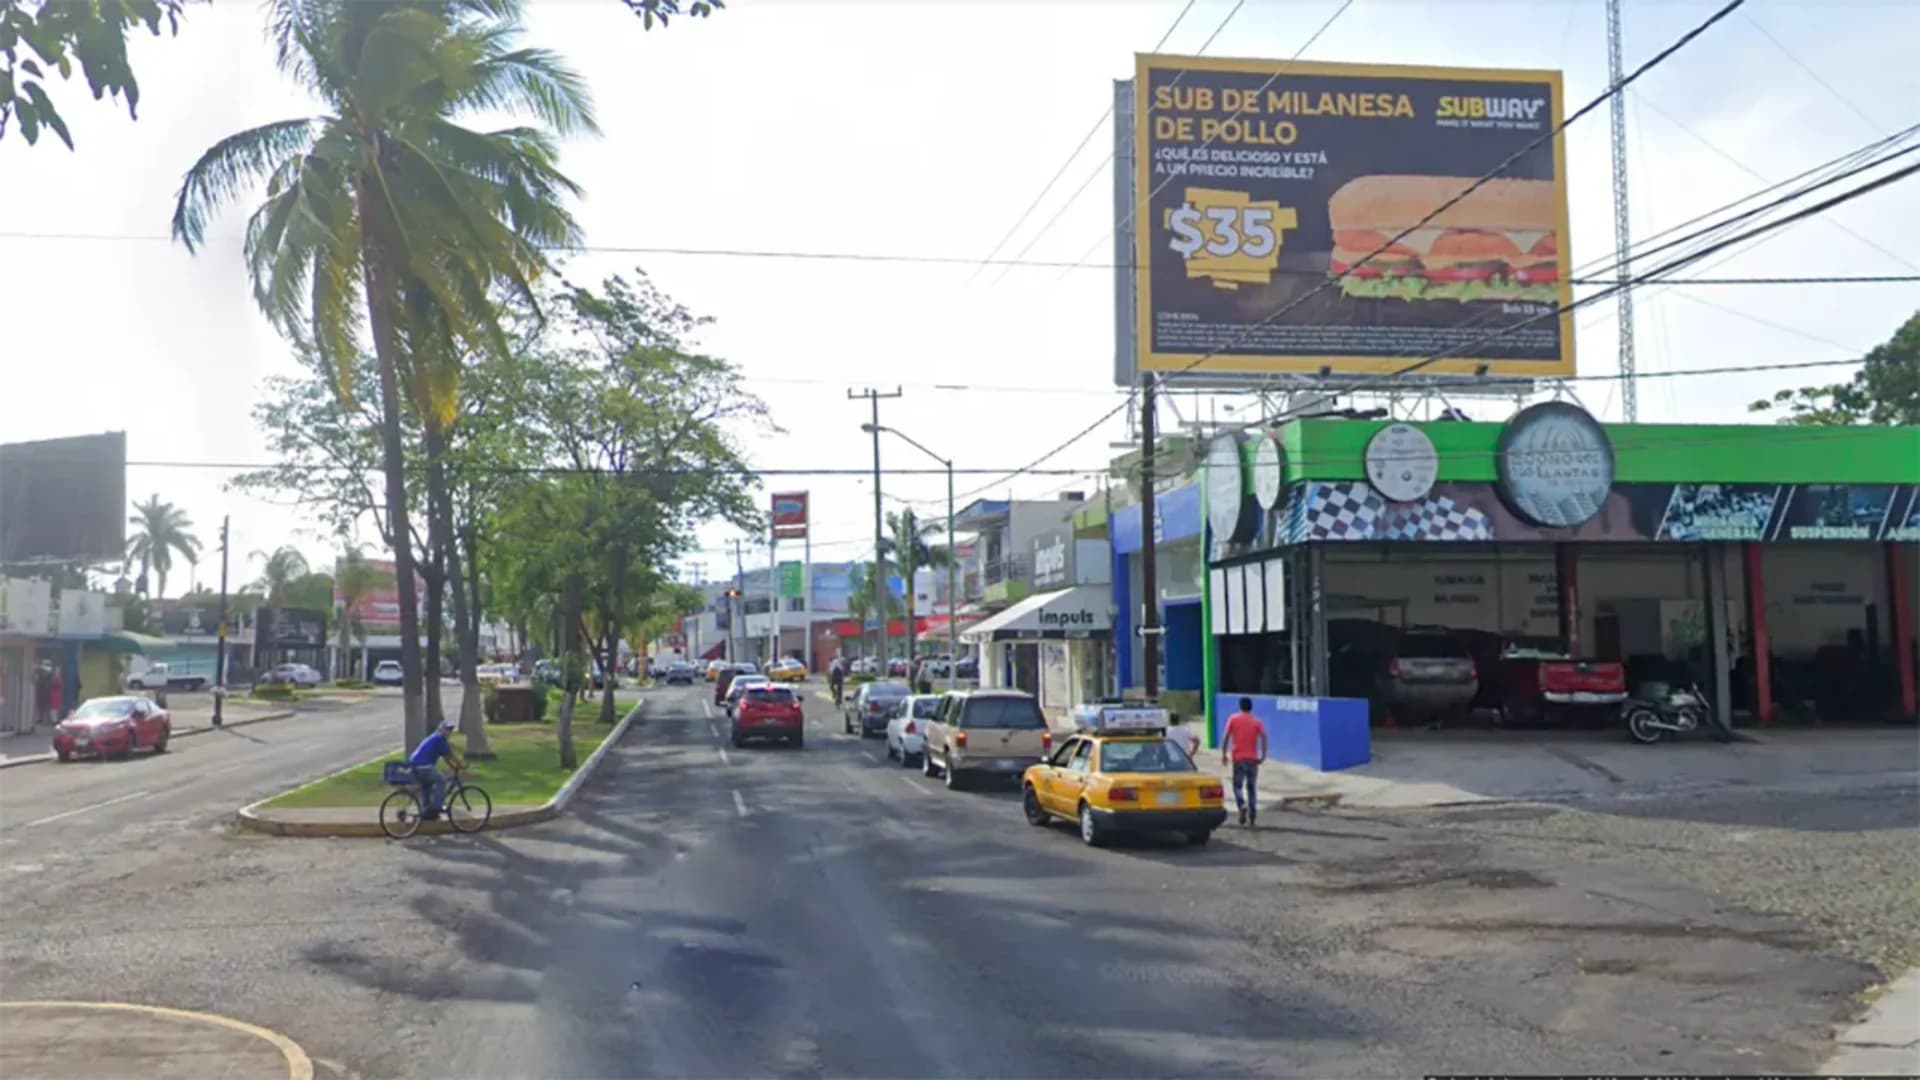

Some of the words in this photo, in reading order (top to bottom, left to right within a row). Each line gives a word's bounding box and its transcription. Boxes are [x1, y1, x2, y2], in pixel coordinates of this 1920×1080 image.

[1154, 86, 1214, 110] SUB
[1222, 88, 1260, 113] DE
[1267, 91, 1415, 118] MILANESA
[1435, 96, 1544, 119] SUBWAY
[1154, 117, 1194, 141] DE
[1201, 119, 1297, 144] POLLO
[1211, 149, 1281, 163] DELICIOSO
[1283, 152, 1291, 163] Y
[1294, 150, 1327, 164] ESTÁ
[1155, 162, 1165, 174] A
[1167, 163, 1187, 175] UN
[1189, 164, 1238, 177] PRECIO
[1240, 164, 1315, 179] INCREÍBLE?
[1169, 203, 1276, 258] $35
[1790, 521, 1870, 539] SUSPENSIÓN
[1038, 608, 1094, 627] impuls
